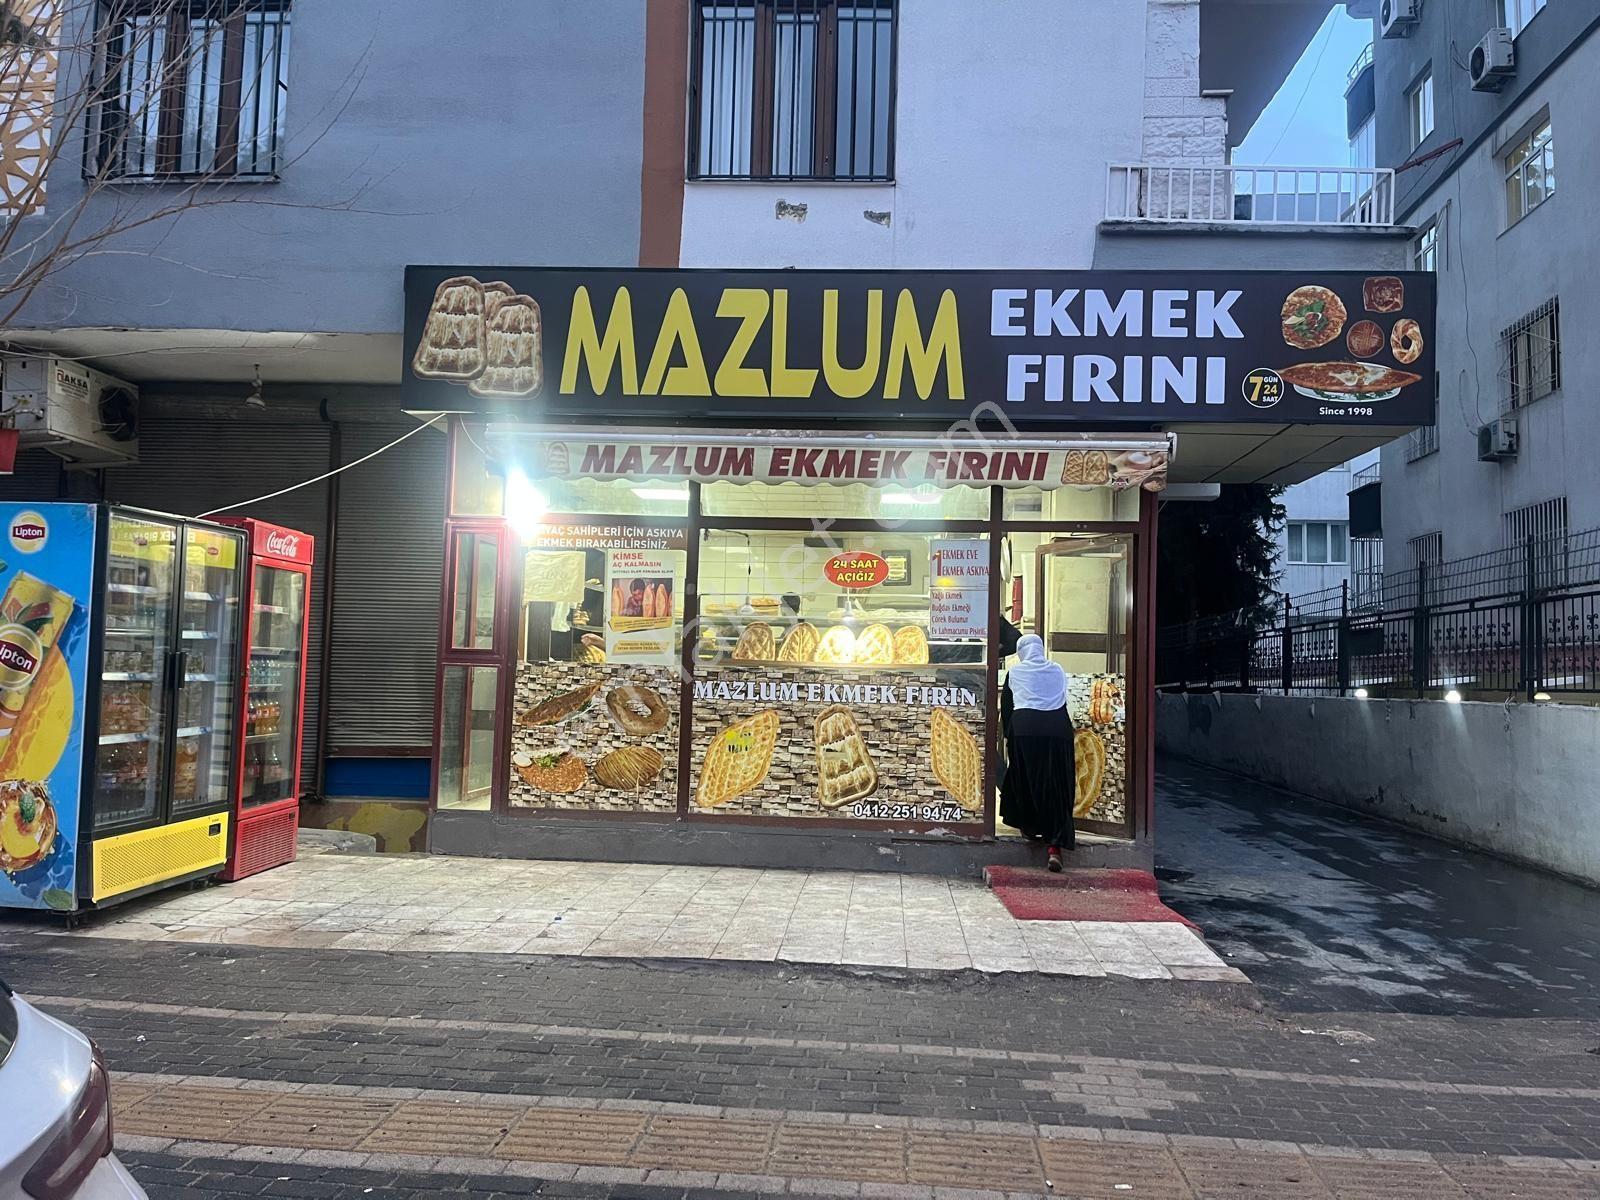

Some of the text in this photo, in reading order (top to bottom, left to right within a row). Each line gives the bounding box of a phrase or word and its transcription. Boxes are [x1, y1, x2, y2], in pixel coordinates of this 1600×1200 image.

[990, 288, 1244, 338] EKMEK
[559, 286, 965, 400] MAZLUM
[1006, 354, 1226, 405] FIRINI
[1263, 375, 1278, 383] GÜN
[1249, 376, 1264, 402] 7
[1263, 384, 1278, 395] 24
[1262, 395, 1278, 403] SAAT
[1319, 407, 1373, 415] Since 1998
[580, 445, 1049, 481] MAZLUM EKMEK FIRINI
[15, 527, 43, 538] Lipton
[567, 525, 620, 537] SAHİPLERİ
[623, 526, 644, 538] İÇİN
[646, 528, 683, 539] ASKIYA
[537, 537, 573, 548] EKMEK
[613, 552, 644, 560] KİMSE
[942, 550, 965, 560] EKMEK
[966, 550, 979, 560] EVE
[833, 559, 879, 569] 24 SAAT
[837, 570, 875, 583] AÇIĞIZ
[942, 566, 992, 577] EKMEK ASKIYA
[945, 592, 963, 600] Ekmek
[0, 644, 33, 670] ipton
[694, 681, 977, 707] MAZLUM EKMEK FIRIN
[854, 804, 962, 820] 0412 251 94 74
